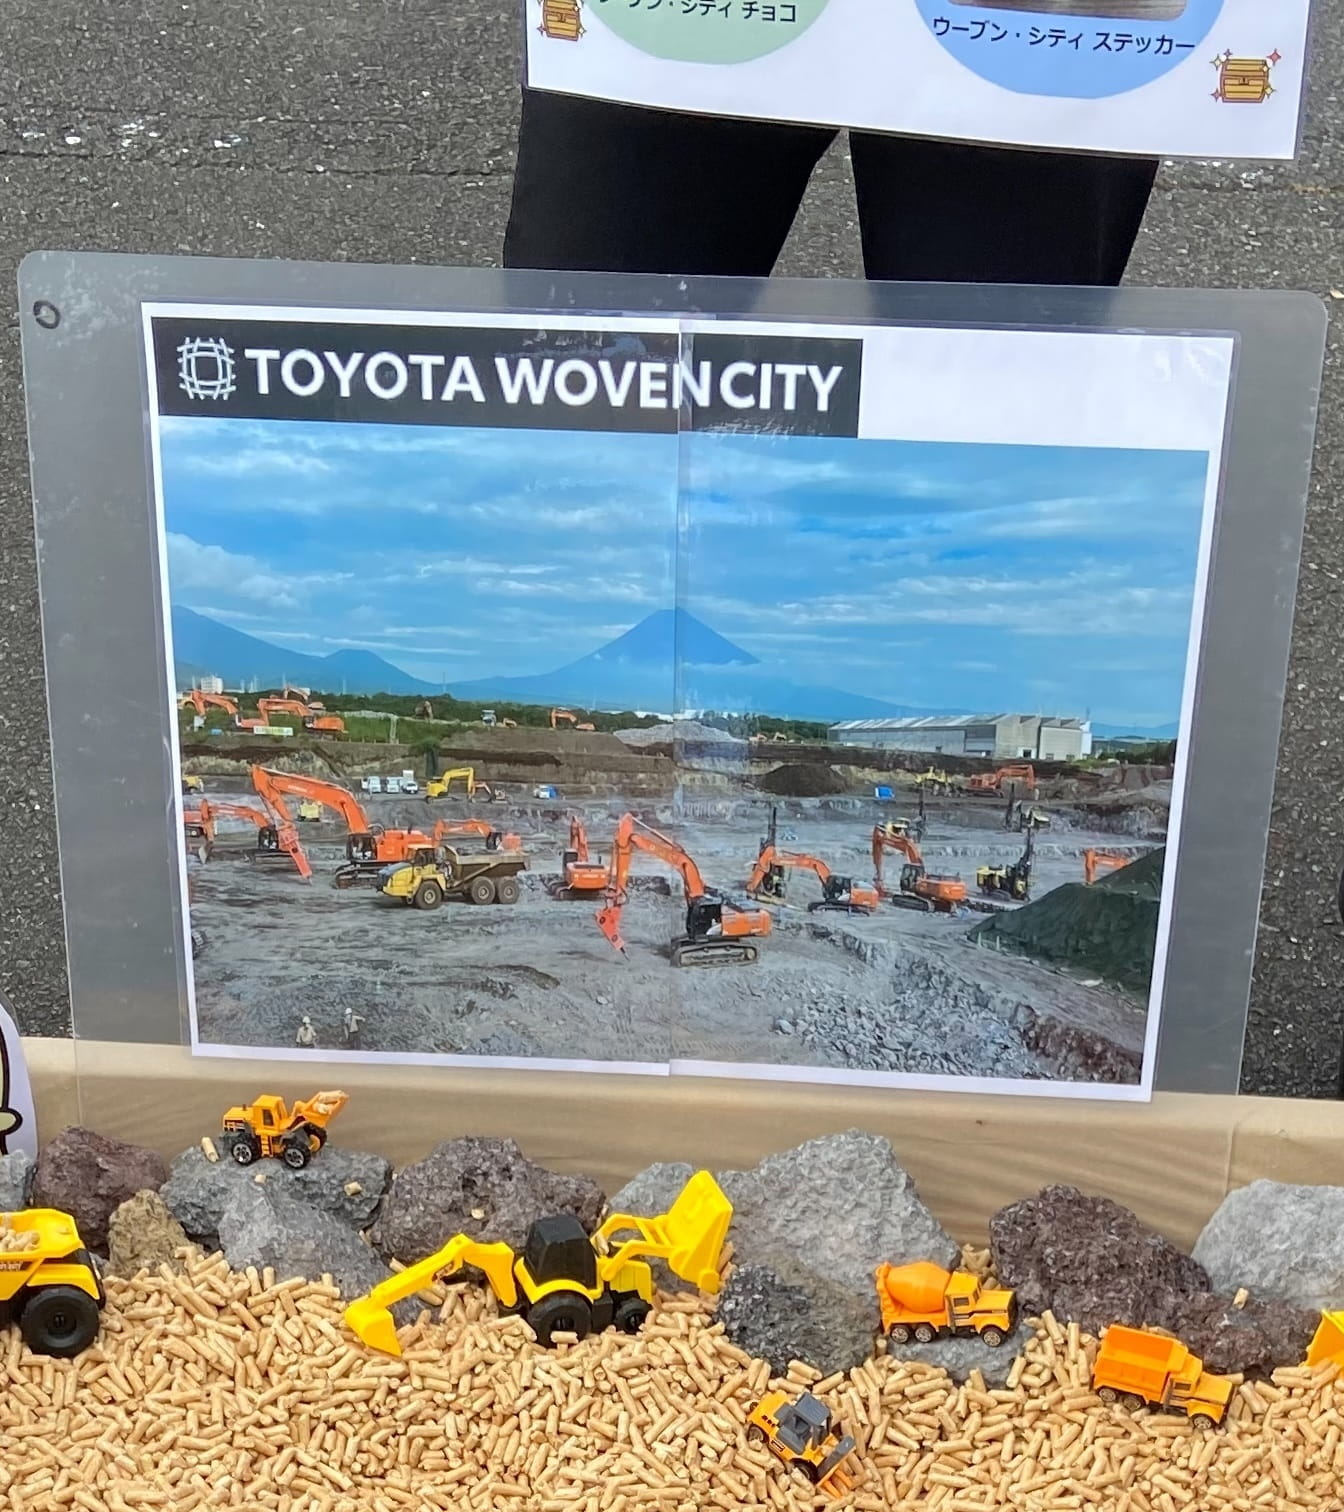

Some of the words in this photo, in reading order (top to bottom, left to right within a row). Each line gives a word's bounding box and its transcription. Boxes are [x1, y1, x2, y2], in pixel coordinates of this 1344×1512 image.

[742, 1, 797, 23] チョコ
[933, 16, 1084, 50] ウーブン・シティ
[1092, 31, 1196, 56] ステッカー
[244, 347, 486, 402] TOYOTA
[495, 356, 712, 410] WOVEN
[720, 361, 844, 412] CITY
